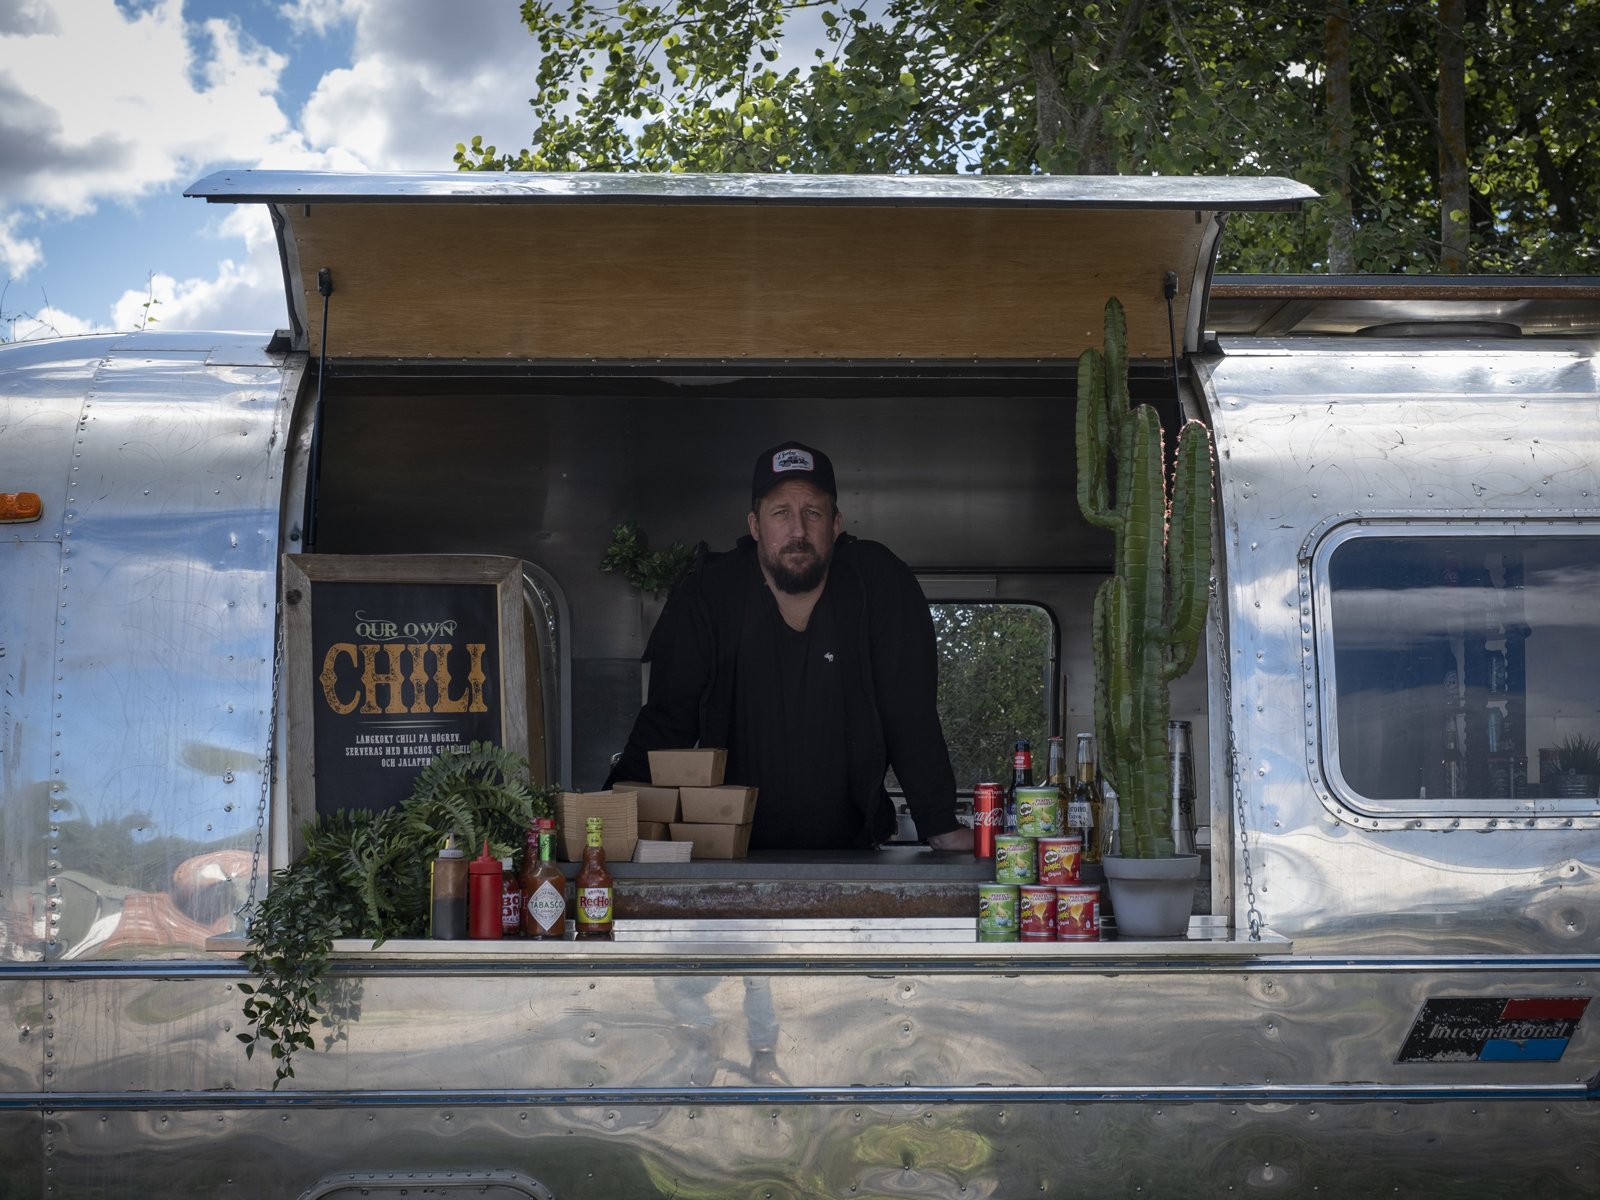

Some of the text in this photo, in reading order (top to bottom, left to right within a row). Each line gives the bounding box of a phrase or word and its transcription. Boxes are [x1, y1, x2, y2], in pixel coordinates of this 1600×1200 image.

[403, 620, 457, 638] OWN
[319, 643, 488, 715] CHILI
[355, 734, 394, 744] LÅNGKOKT
[395, 734, 416, 744] CHILI
[345, 747, 383, 756] SERVERAS
[385, 746, 401, 755] MED
[381, 757, 434, 768] OCH JALAPEN
[580, 896, 613, 907] RedHo
[1428, 1022, 1569, 1040] International
